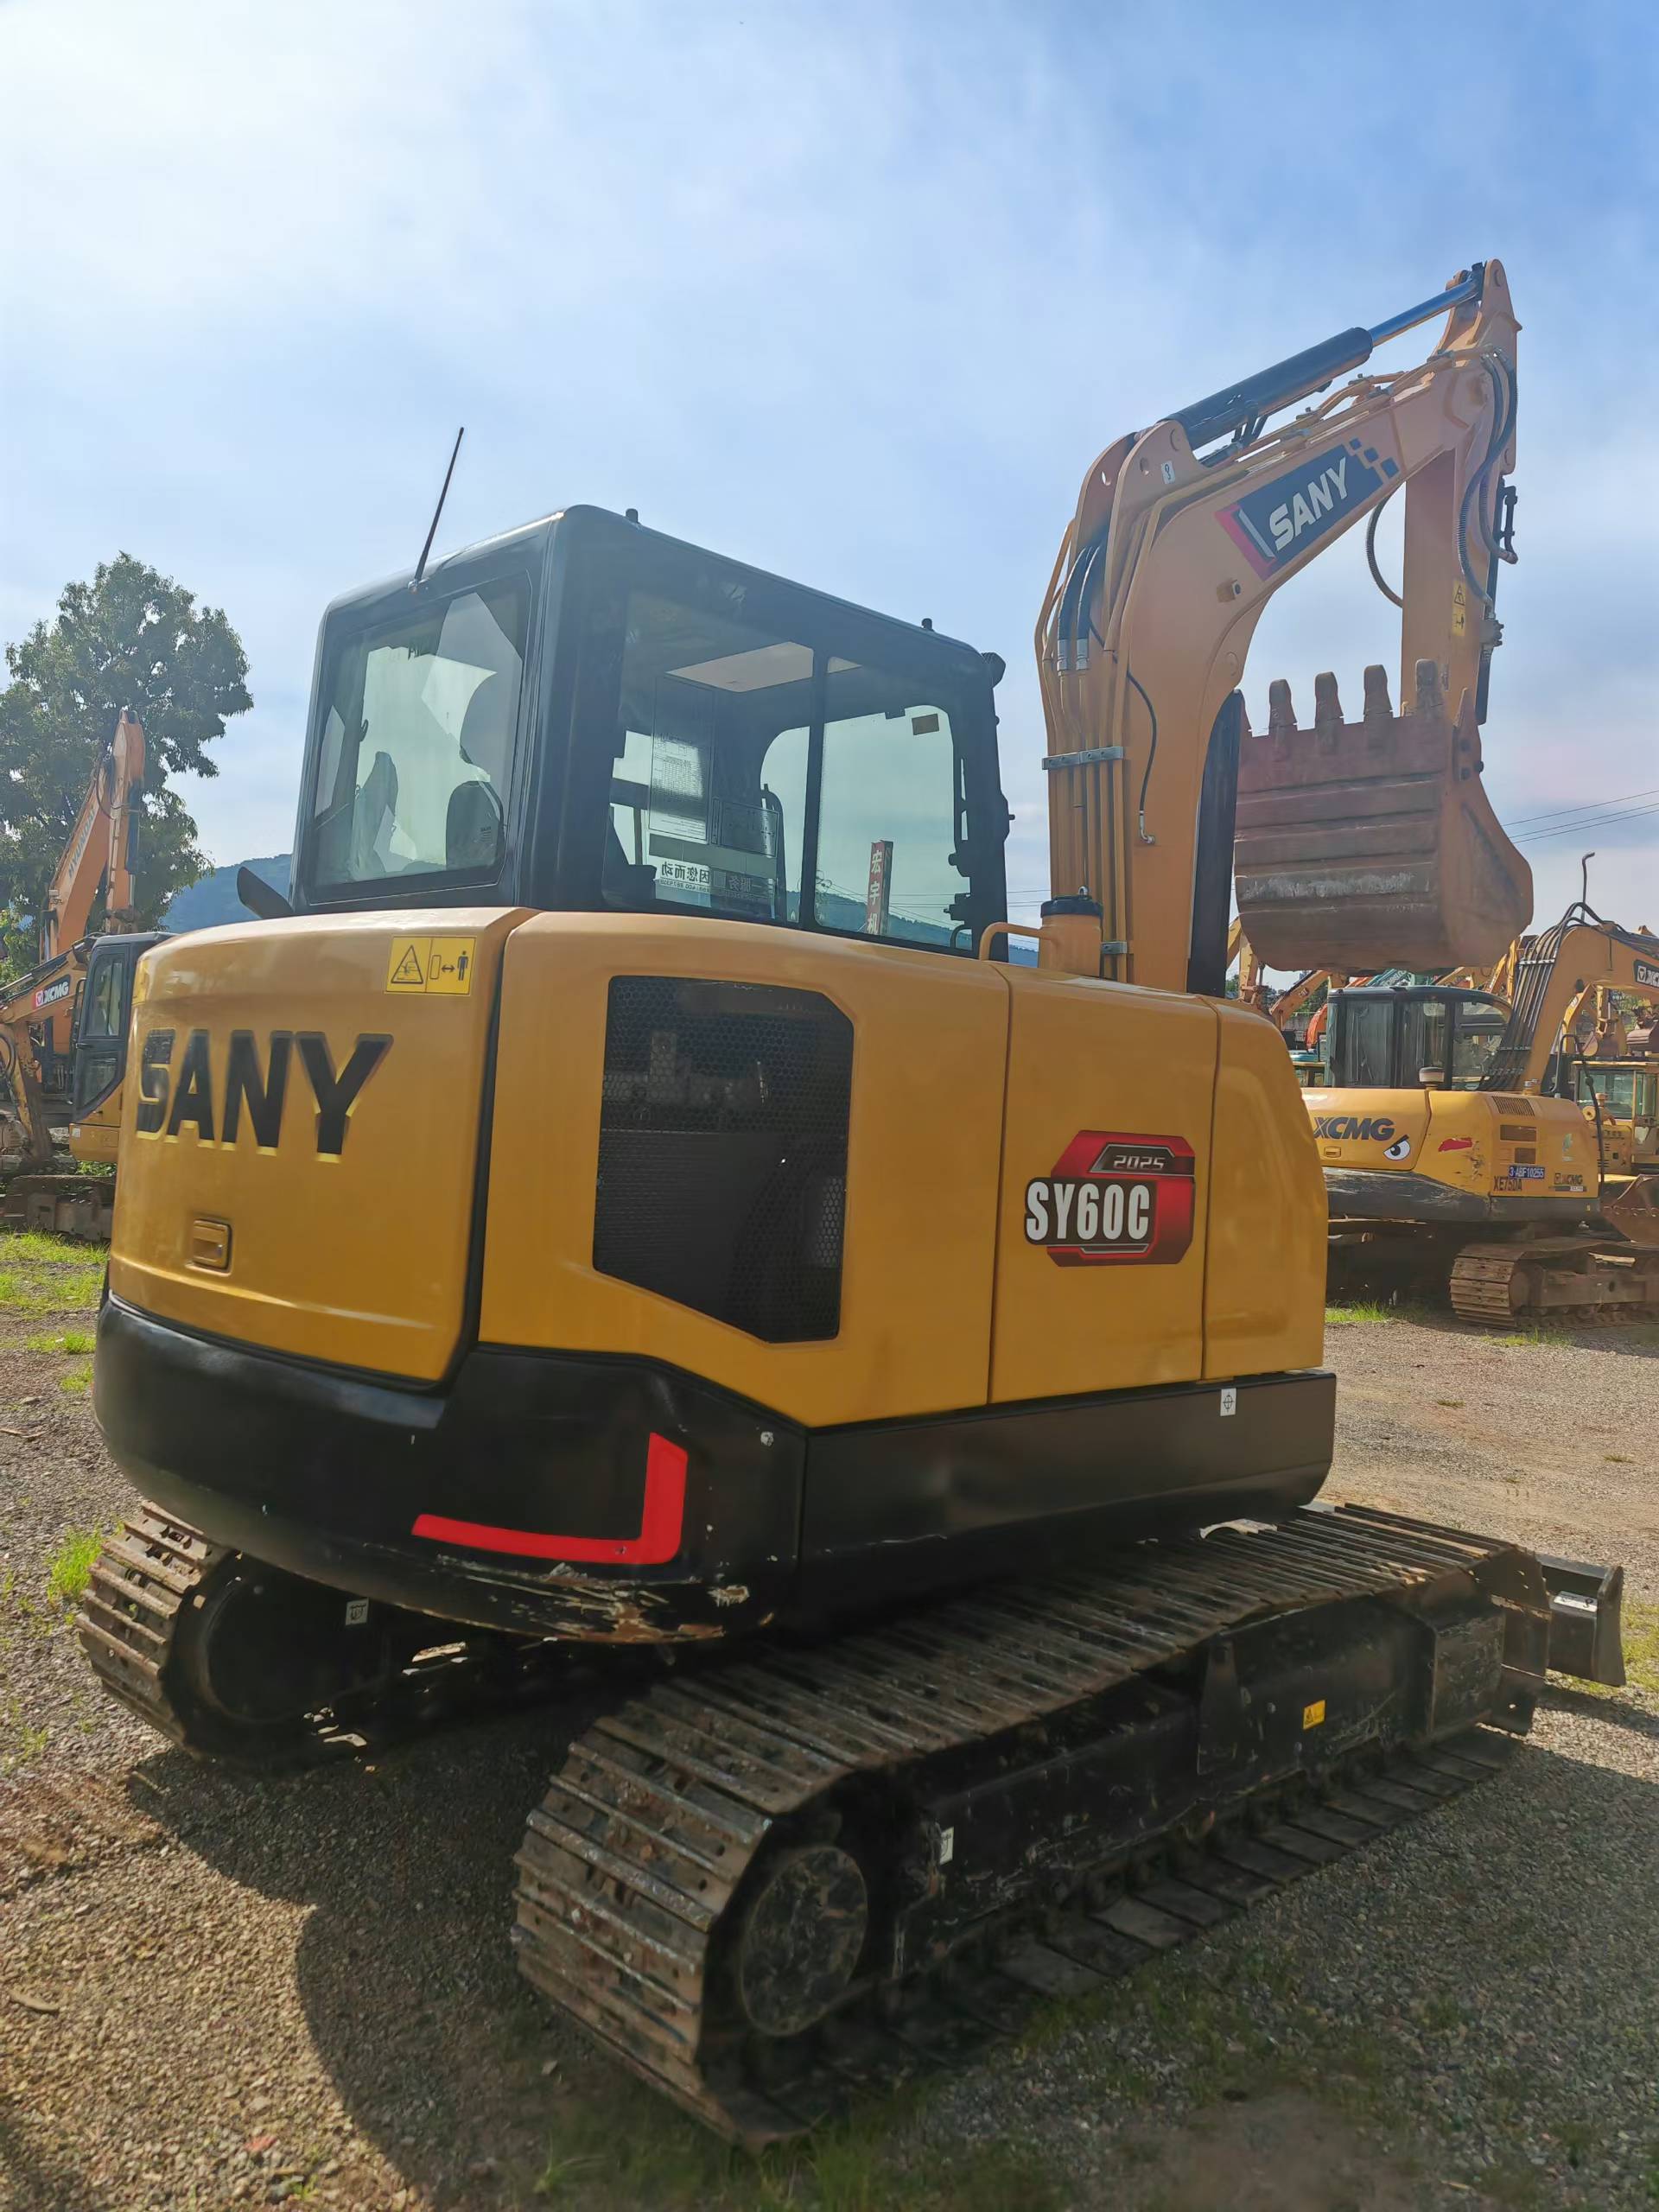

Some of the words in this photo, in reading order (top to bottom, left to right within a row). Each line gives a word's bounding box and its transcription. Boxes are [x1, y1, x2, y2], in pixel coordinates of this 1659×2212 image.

[1269, 456, 1347, 550] SANY
[44, 981, 69, 1003] XCMG
[136, 1027, 395, 1164] SANY
[1313, 1116, 1395, 1141] XCMG
[1113, 1154, 1166, 1171] 2025
[1026, 1181, 1150, 1241] SY60C
